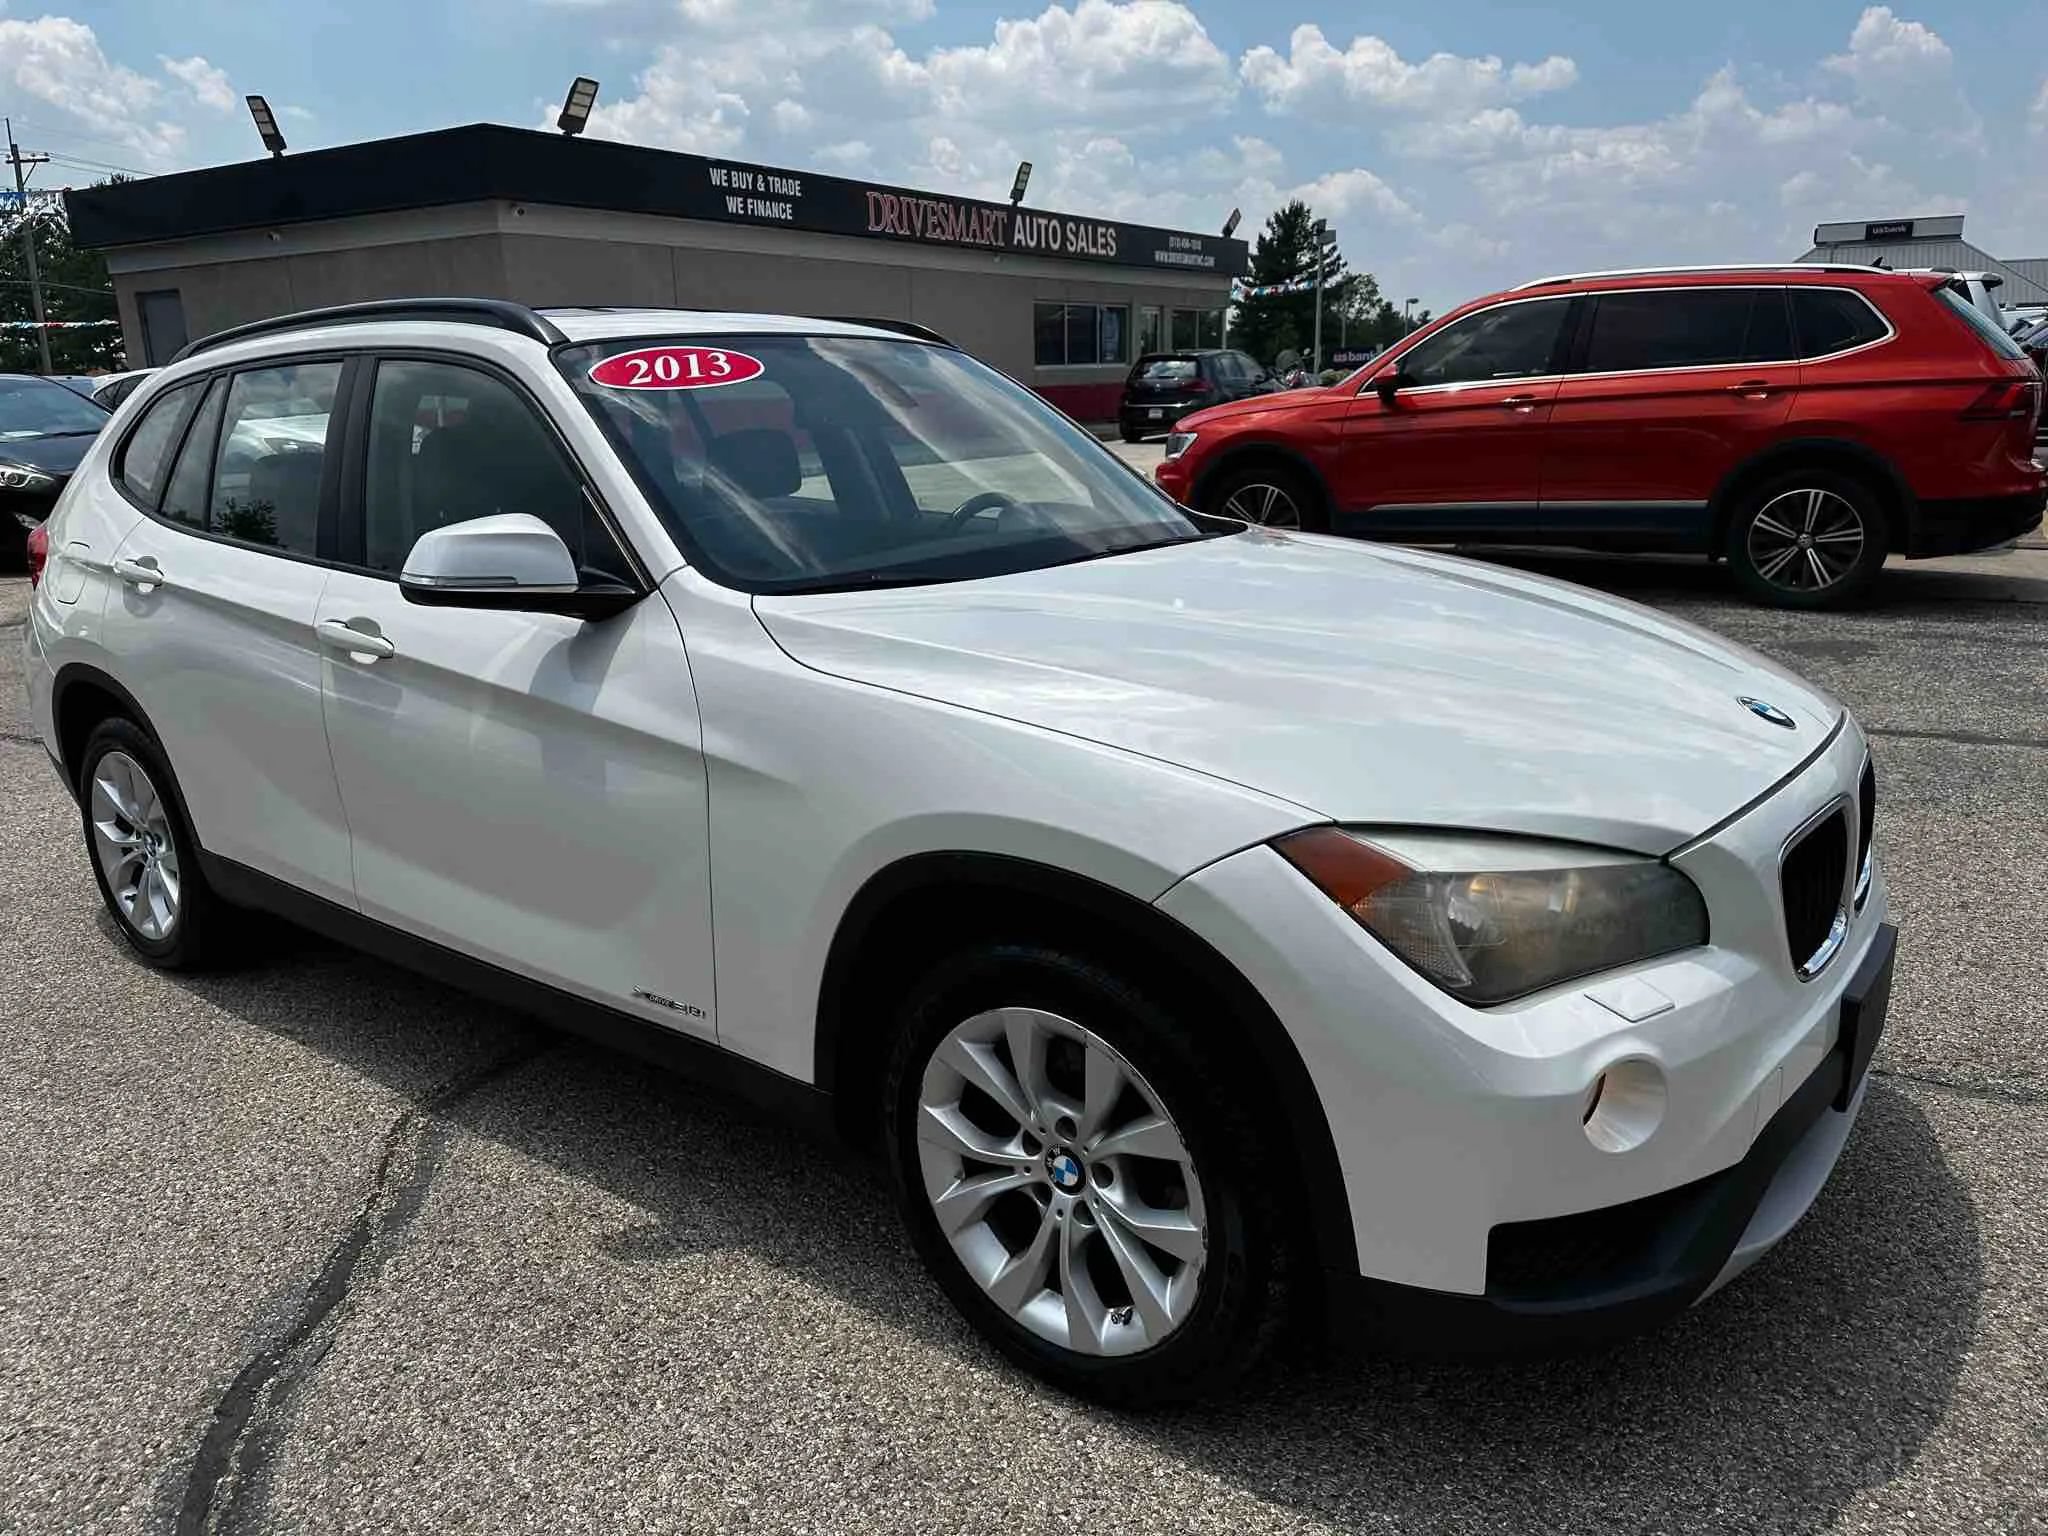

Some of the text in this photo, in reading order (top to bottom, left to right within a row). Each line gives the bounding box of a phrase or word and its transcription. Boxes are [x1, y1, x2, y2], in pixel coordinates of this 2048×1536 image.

[709, 167, 802, 197] WE BUY & TRADE
[726, 195, 793, 220] WE FINANCE
[866, 191, 1116, 256] DRIVESMART AUTO SALES
[625, 352, 731, 384] 2013
